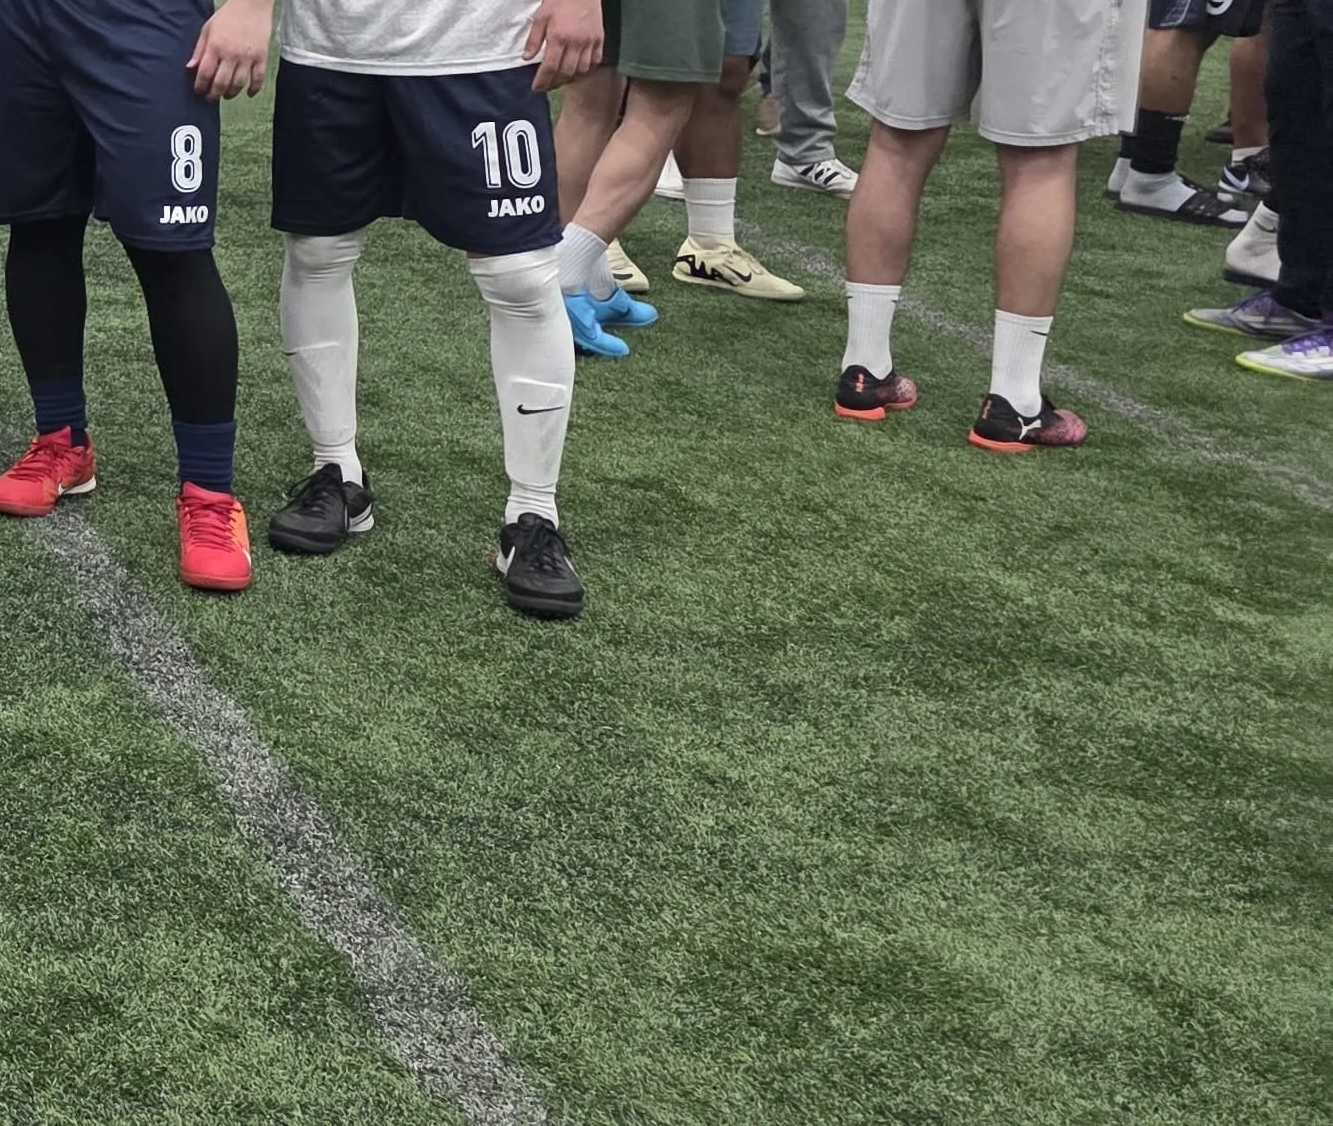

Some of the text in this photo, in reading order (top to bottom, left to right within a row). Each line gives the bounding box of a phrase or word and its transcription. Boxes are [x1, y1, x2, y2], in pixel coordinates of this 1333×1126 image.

[170, 124, 204, 193] 8
[470, 119, 542, 190] 10
[159, 205, 208, 224] JAKO
[487, 195, 545, 218] JAKO
